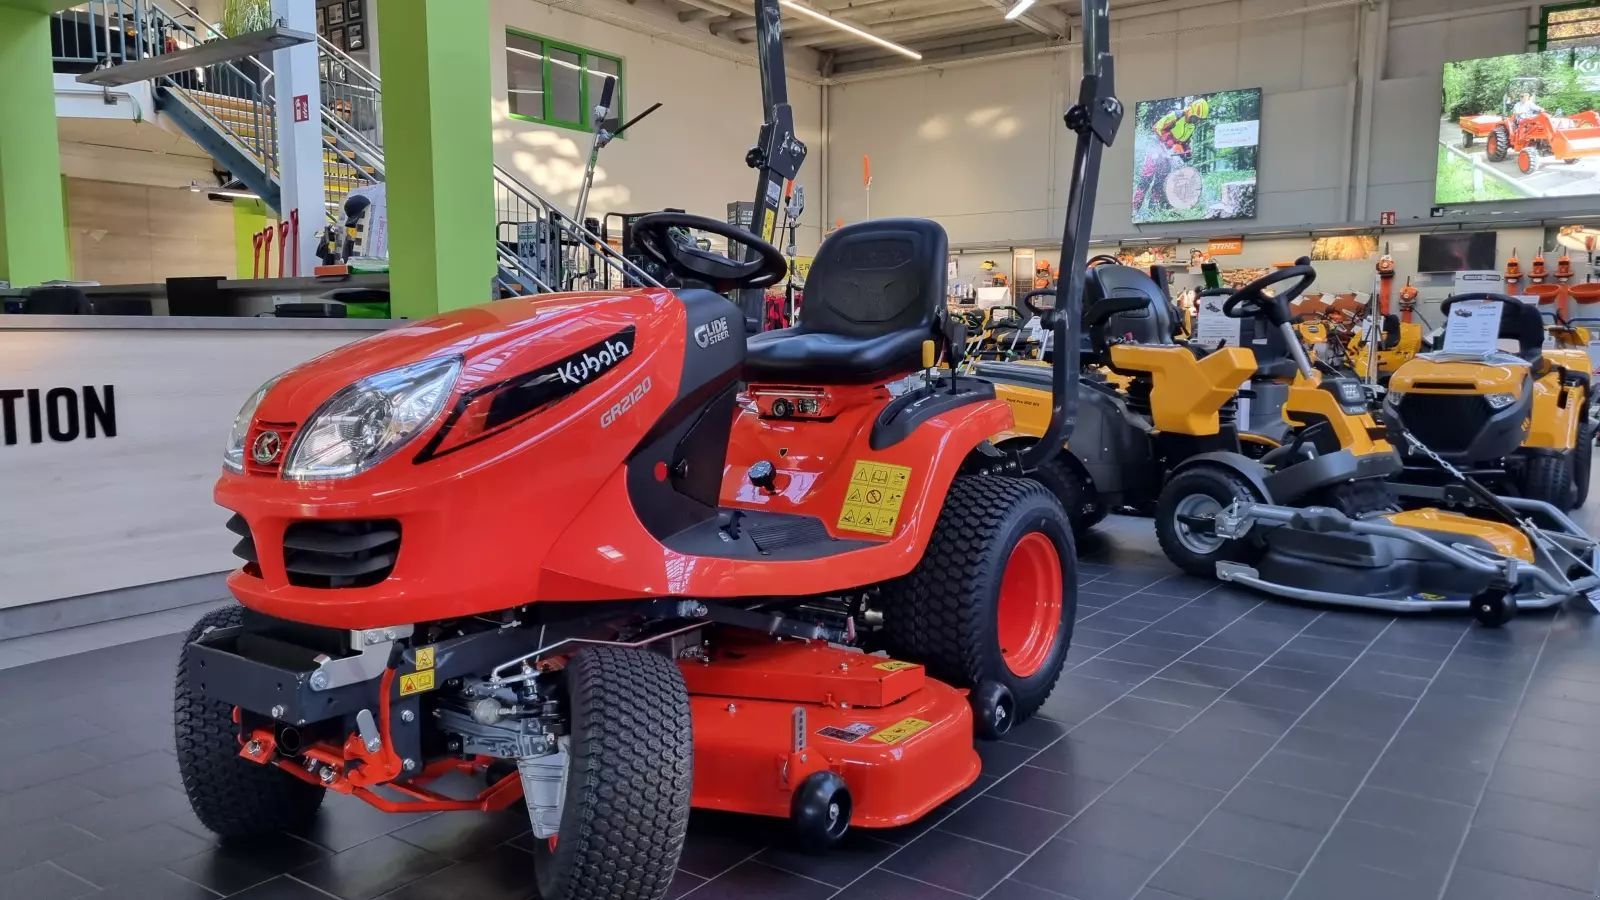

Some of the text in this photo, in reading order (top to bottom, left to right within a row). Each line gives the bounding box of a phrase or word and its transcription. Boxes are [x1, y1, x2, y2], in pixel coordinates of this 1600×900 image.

[694, 316, 728, 349] GLIDE
[709, 329, 730, 345] STEER
[557, 340, 630, 384] Kubota
[0, 384, 118, 446] TION
[600, 376, 652, 429] GR2120
